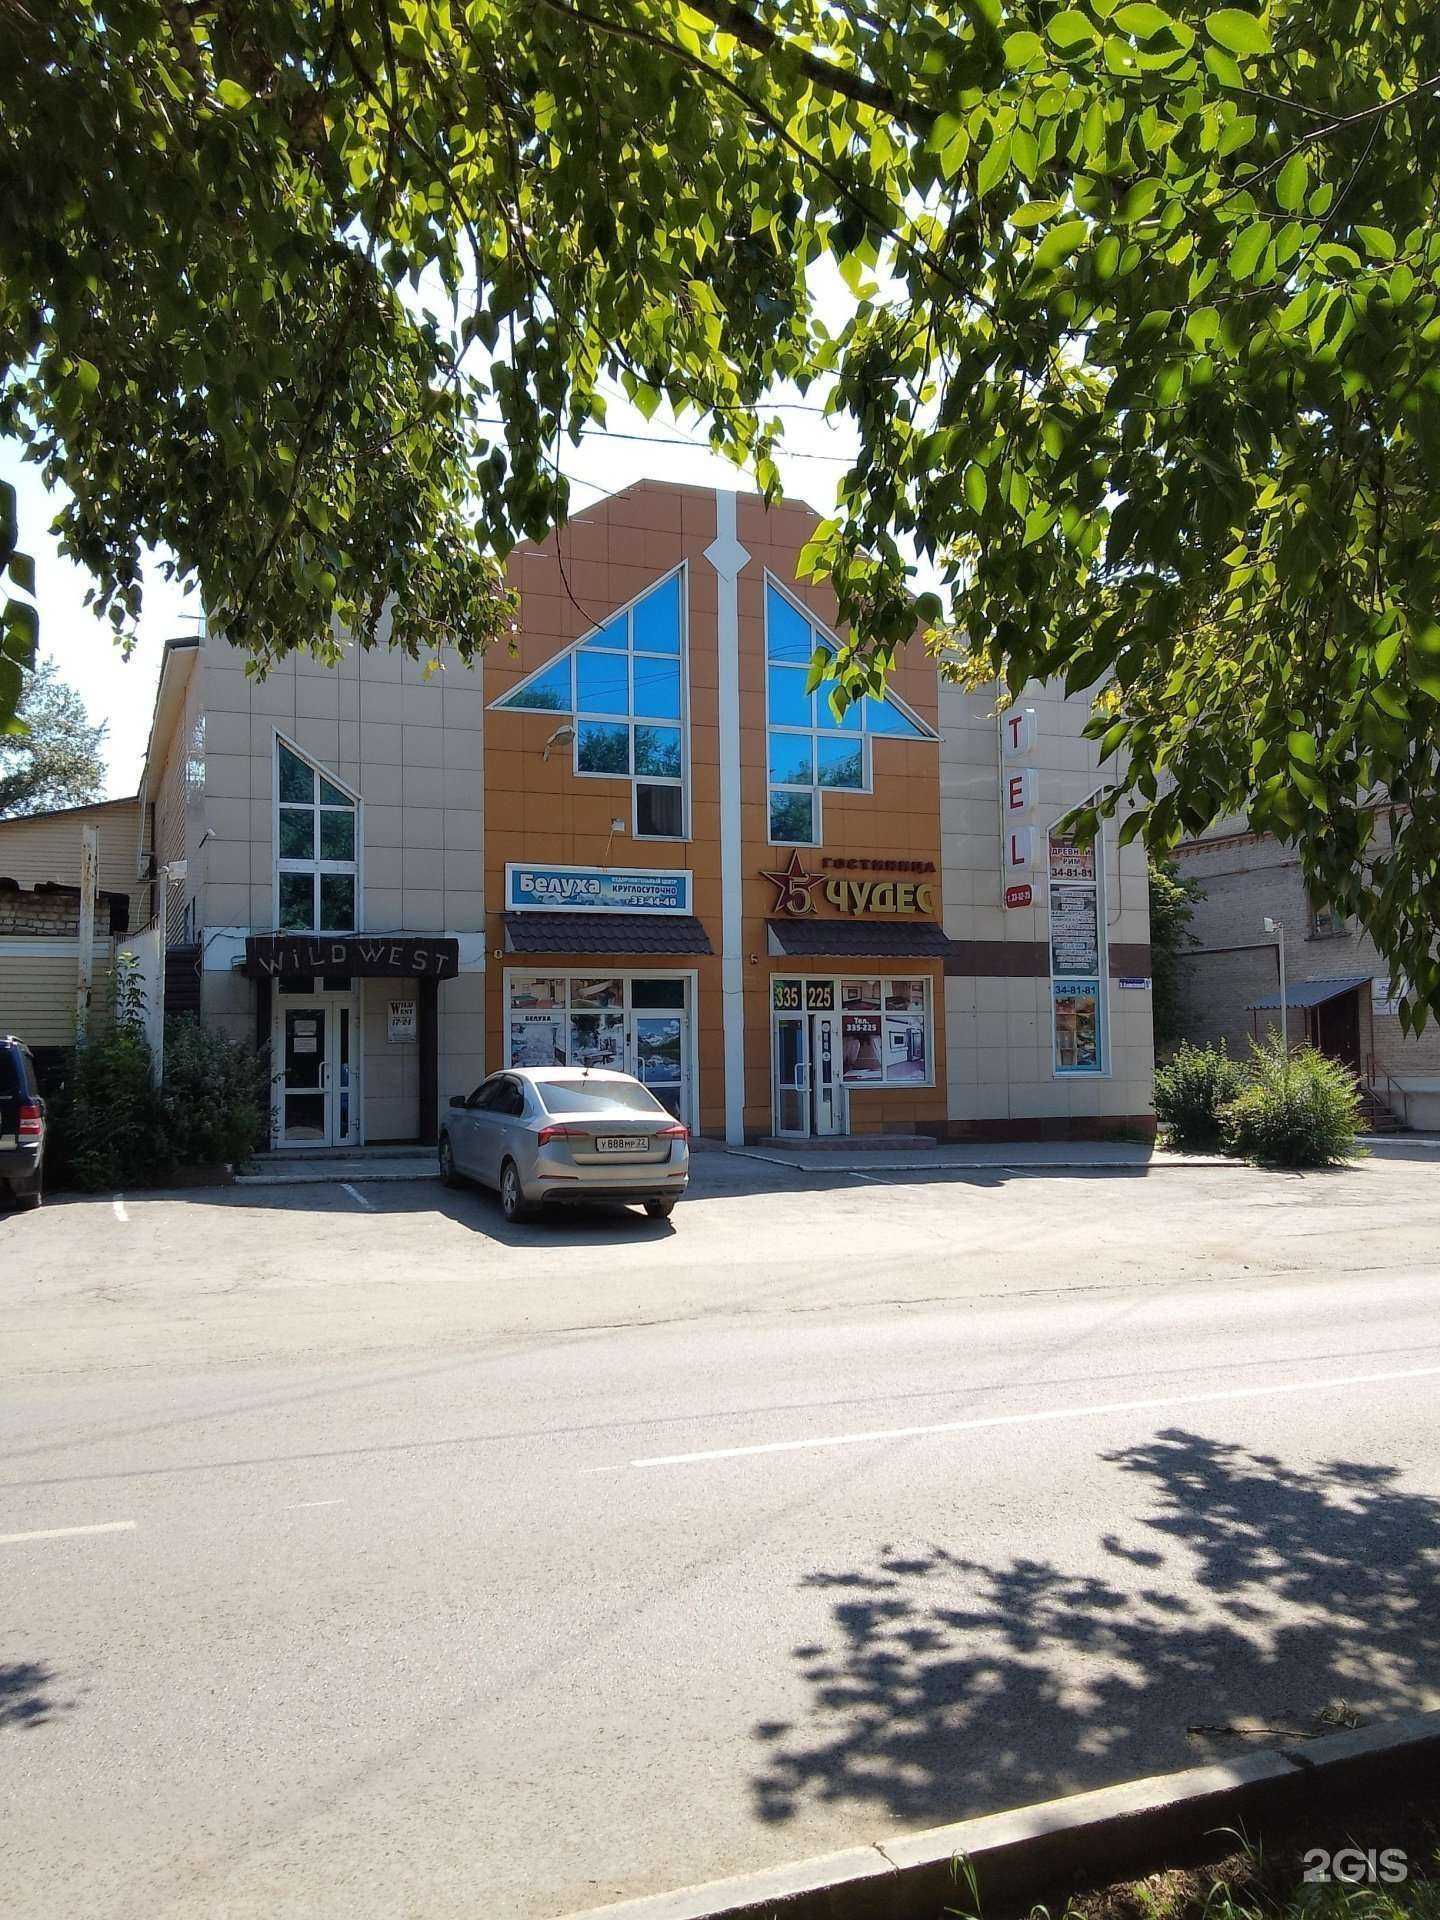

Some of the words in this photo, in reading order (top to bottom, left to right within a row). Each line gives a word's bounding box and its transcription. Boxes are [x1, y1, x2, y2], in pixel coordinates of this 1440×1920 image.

[1051, 868, 1093, 877] 34-81-81
[520, 873, 601, 897] Белуха
[612, 885, 678, 895] КРУГЛОСУТОЧНО
[786, 874, 813, 915] 5
[826, 880, 936, 916] ЧУДЕС
[359, 946, 449, 975] WEST
[775, 986, 799, 1007] 335
[808, 986, 832, 1007] 225
[1055, 985, 1096, 994] 34-81-81
[846, 1024, 877, 1032] 335-225
